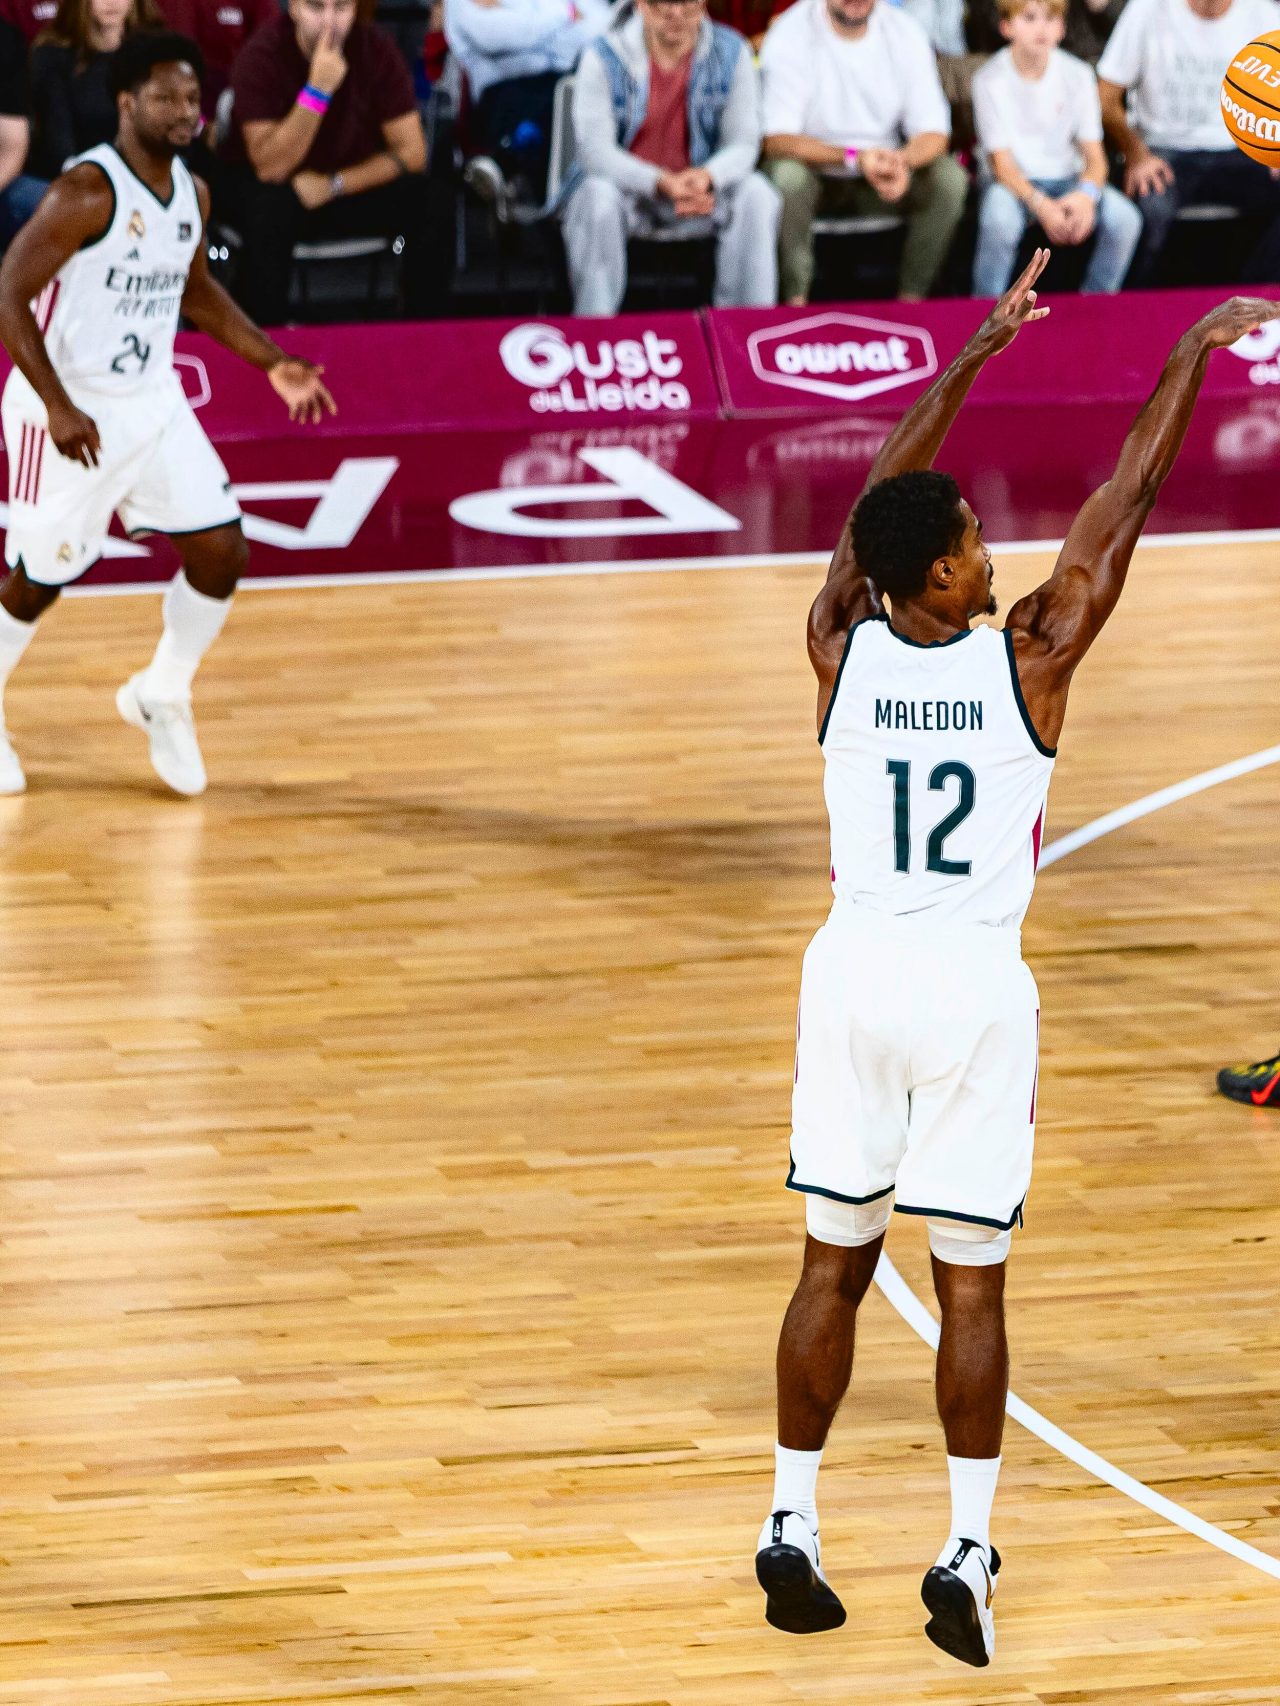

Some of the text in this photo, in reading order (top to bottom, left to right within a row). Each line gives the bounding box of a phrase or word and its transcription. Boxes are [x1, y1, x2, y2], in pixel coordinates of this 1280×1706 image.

[111, 331, 151, 374] 24
[499, 322, 683, 389] Gust
[774, 334, 912, 375] ownat
[874, 698, 984, 731] MALEDON
[885, 758, 977, 877] 12
